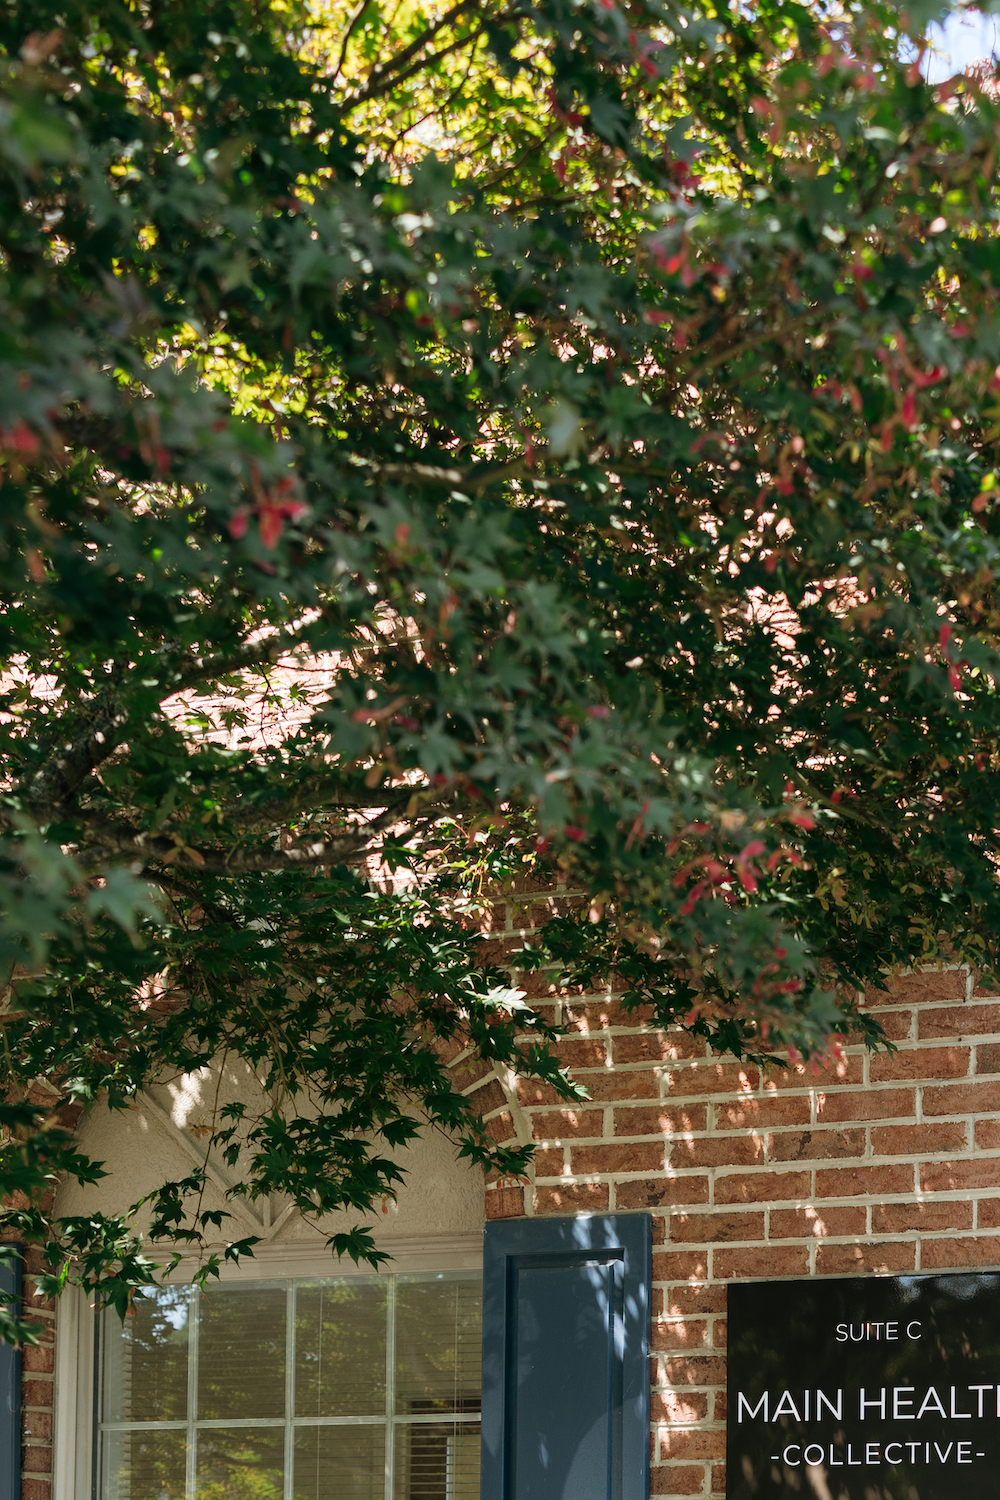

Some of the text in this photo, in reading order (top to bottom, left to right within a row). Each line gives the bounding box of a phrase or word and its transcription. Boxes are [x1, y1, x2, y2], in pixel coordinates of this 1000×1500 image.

[835, 1320, 922, 1342] SUITE C
[737, 1388, 842, 1424] MAIN
[770, 1441, 986, 1467] -COLLECTIVE-
